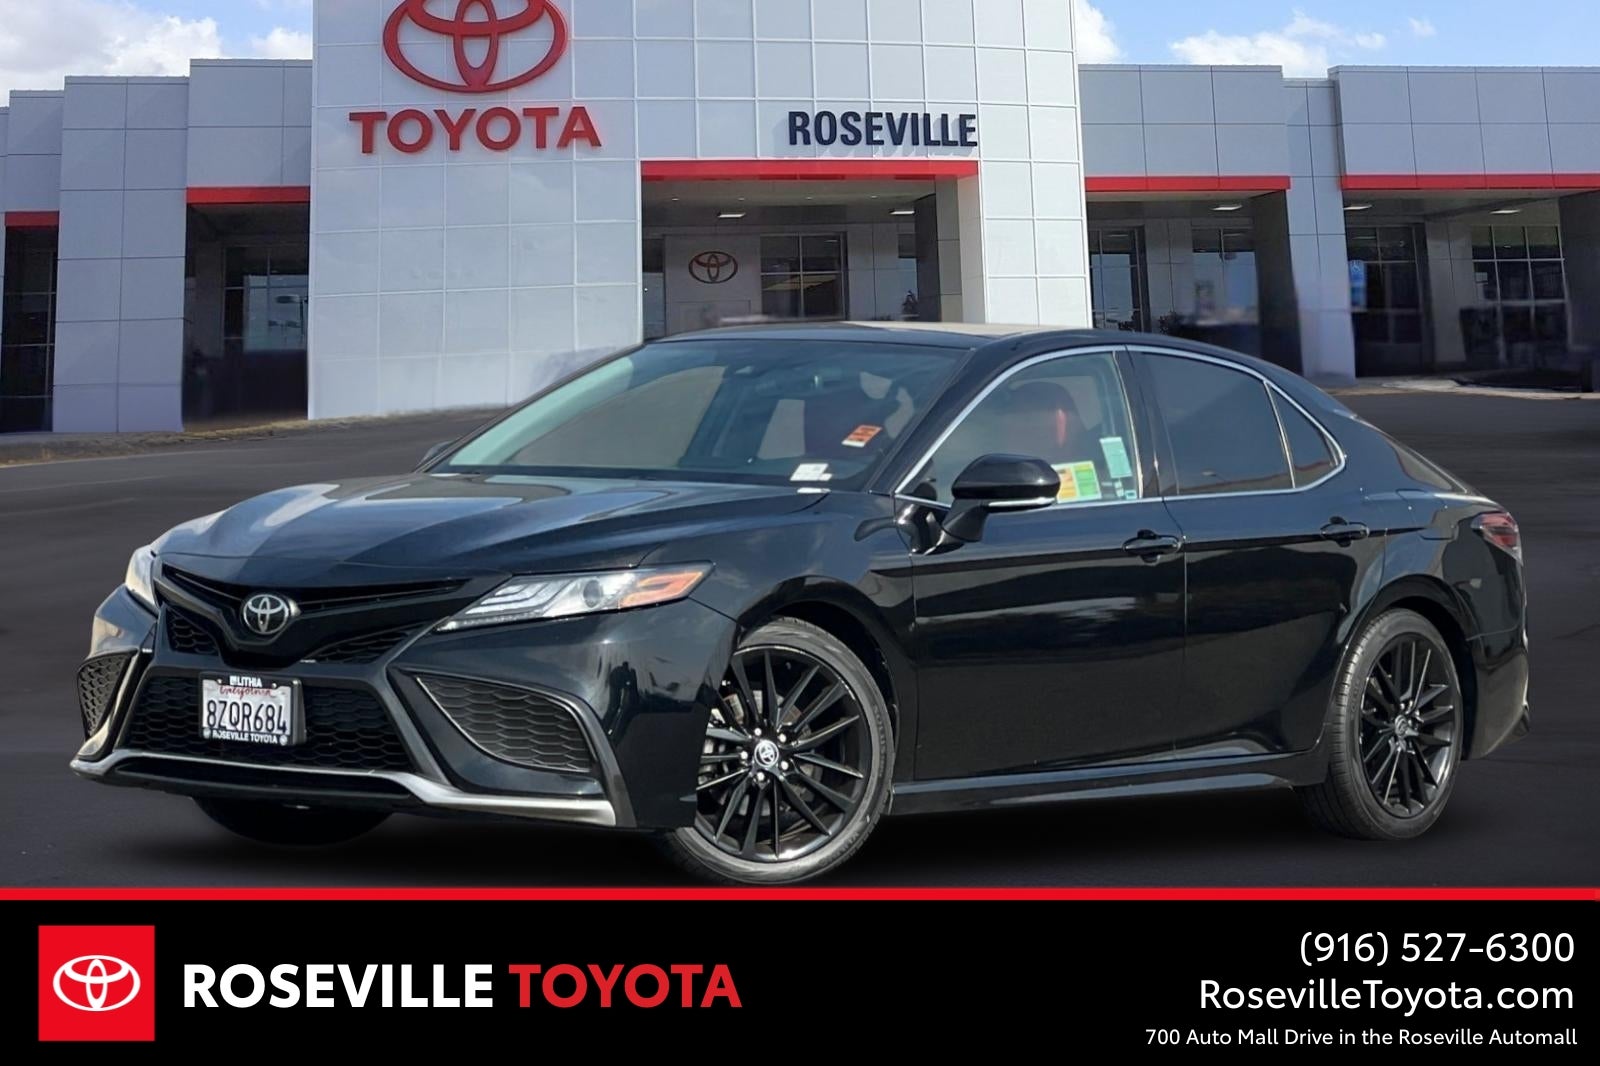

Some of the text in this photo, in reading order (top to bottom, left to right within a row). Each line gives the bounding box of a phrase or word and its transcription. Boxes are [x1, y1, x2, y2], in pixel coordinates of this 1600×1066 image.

[349, 106, 602, 154] TOYOTA
[788, 111, 978, 147] ROSEVILLE
[237, 676, 262, 687] LITHIA
[207, 700, 287, 733] 8ZQR684
[212, 730, 278, 744] ROSEVILLE TOYOTA
